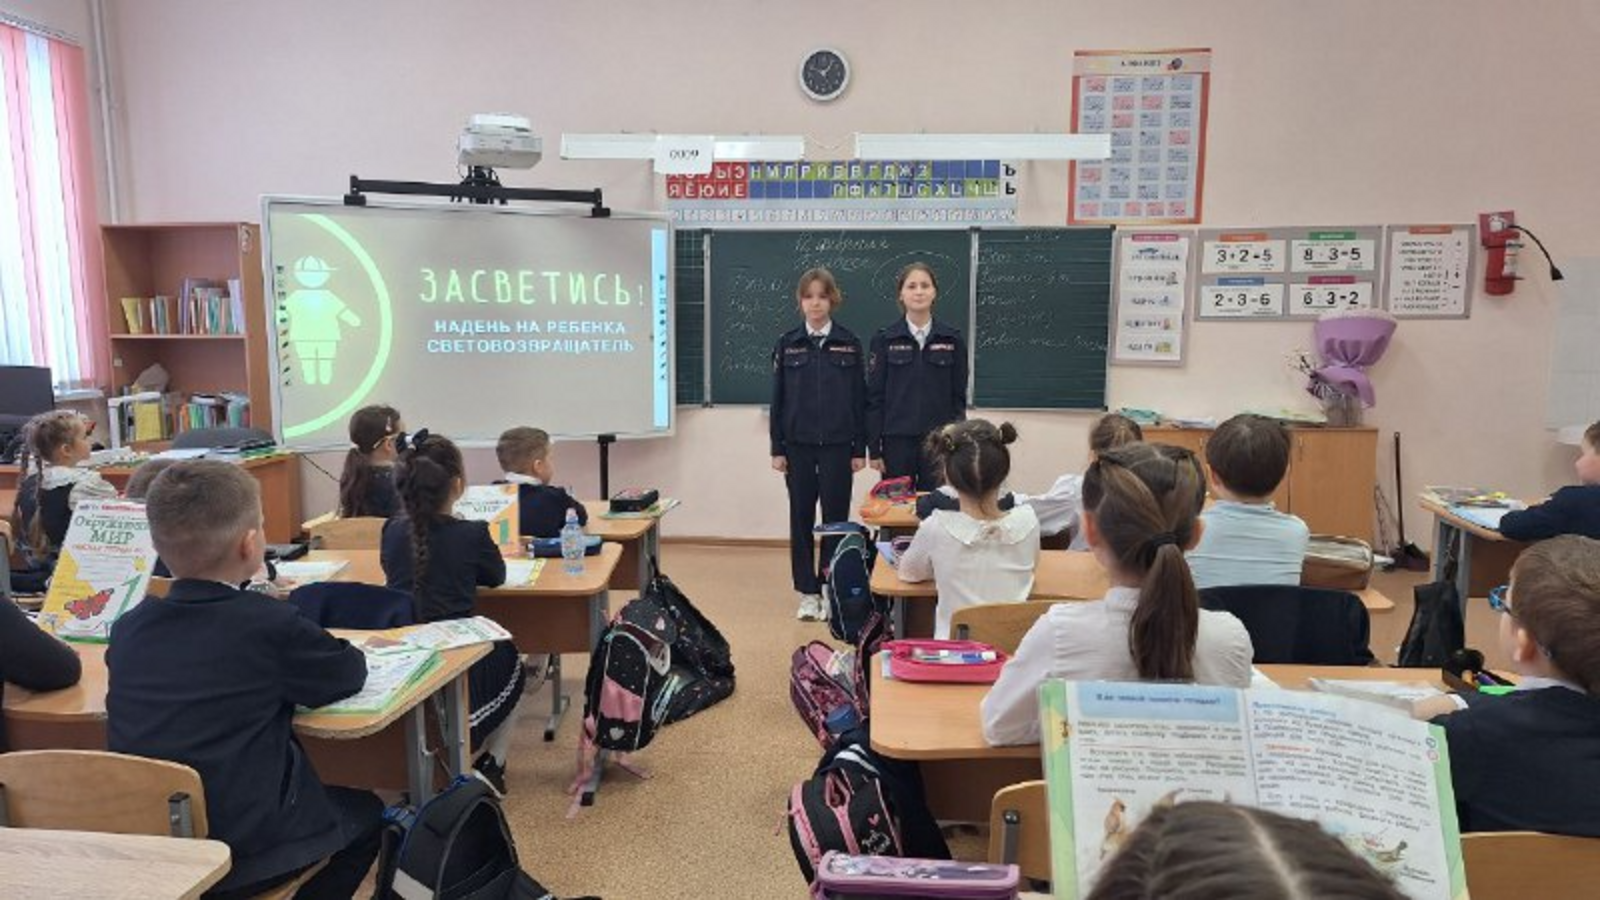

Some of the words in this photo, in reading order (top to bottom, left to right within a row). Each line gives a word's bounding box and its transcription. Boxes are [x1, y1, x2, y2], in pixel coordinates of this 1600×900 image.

[1217, 249, 1227, 262] 3
[1239, 249, 1249, 262] 2
[1262, 249, 1272, 262] 5
[1328, 247, 1339, 260] 3
[1350, 247, 1361, 260] 5
[419, 267, 644, 306] ЗАСВЕТИСЬ!
[1215, 293, 1224, 306] 2
[1237, 293, 1247, 306] 3
[1303, 291, 1313, 305] 6
[1327, 291, 1335, 305] 3
[1349, 291, 1359, 305] 2
[434, 320, 511, 336] НАДЕНЬ
[516, 320, 541, 333] НА
[547, 321, 626, 334] РЕБЕНКА
[426, 339, 635, 354] СВЕТОВОЗВРАЩАТЕЛЬ
[90, 530, 134, 544] МИР
